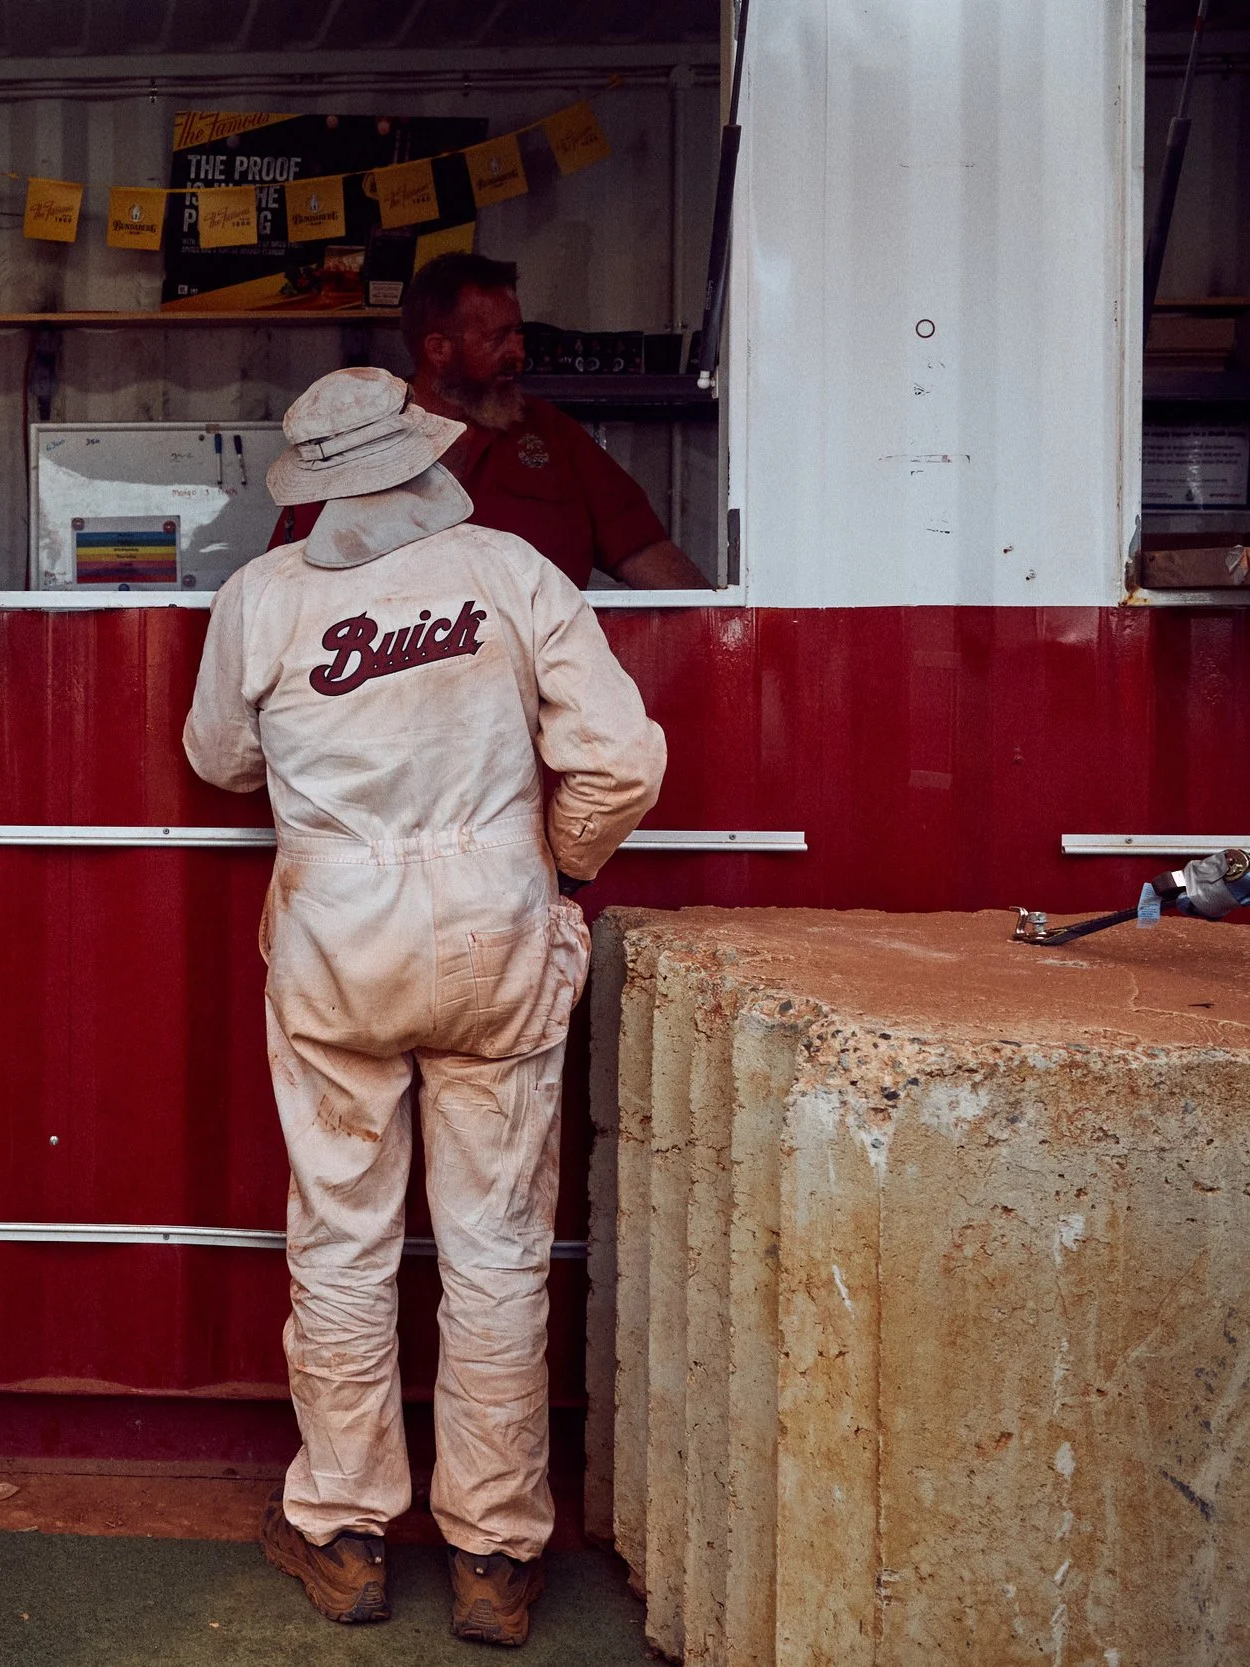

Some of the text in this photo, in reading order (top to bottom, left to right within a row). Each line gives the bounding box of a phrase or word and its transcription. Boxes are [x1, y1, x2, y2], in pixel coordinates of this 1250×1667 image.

[198, 111, 271, 144] Famous
[187, 154, 302, 182] THE PROOF
[309, 600, 488, 696] Buick
